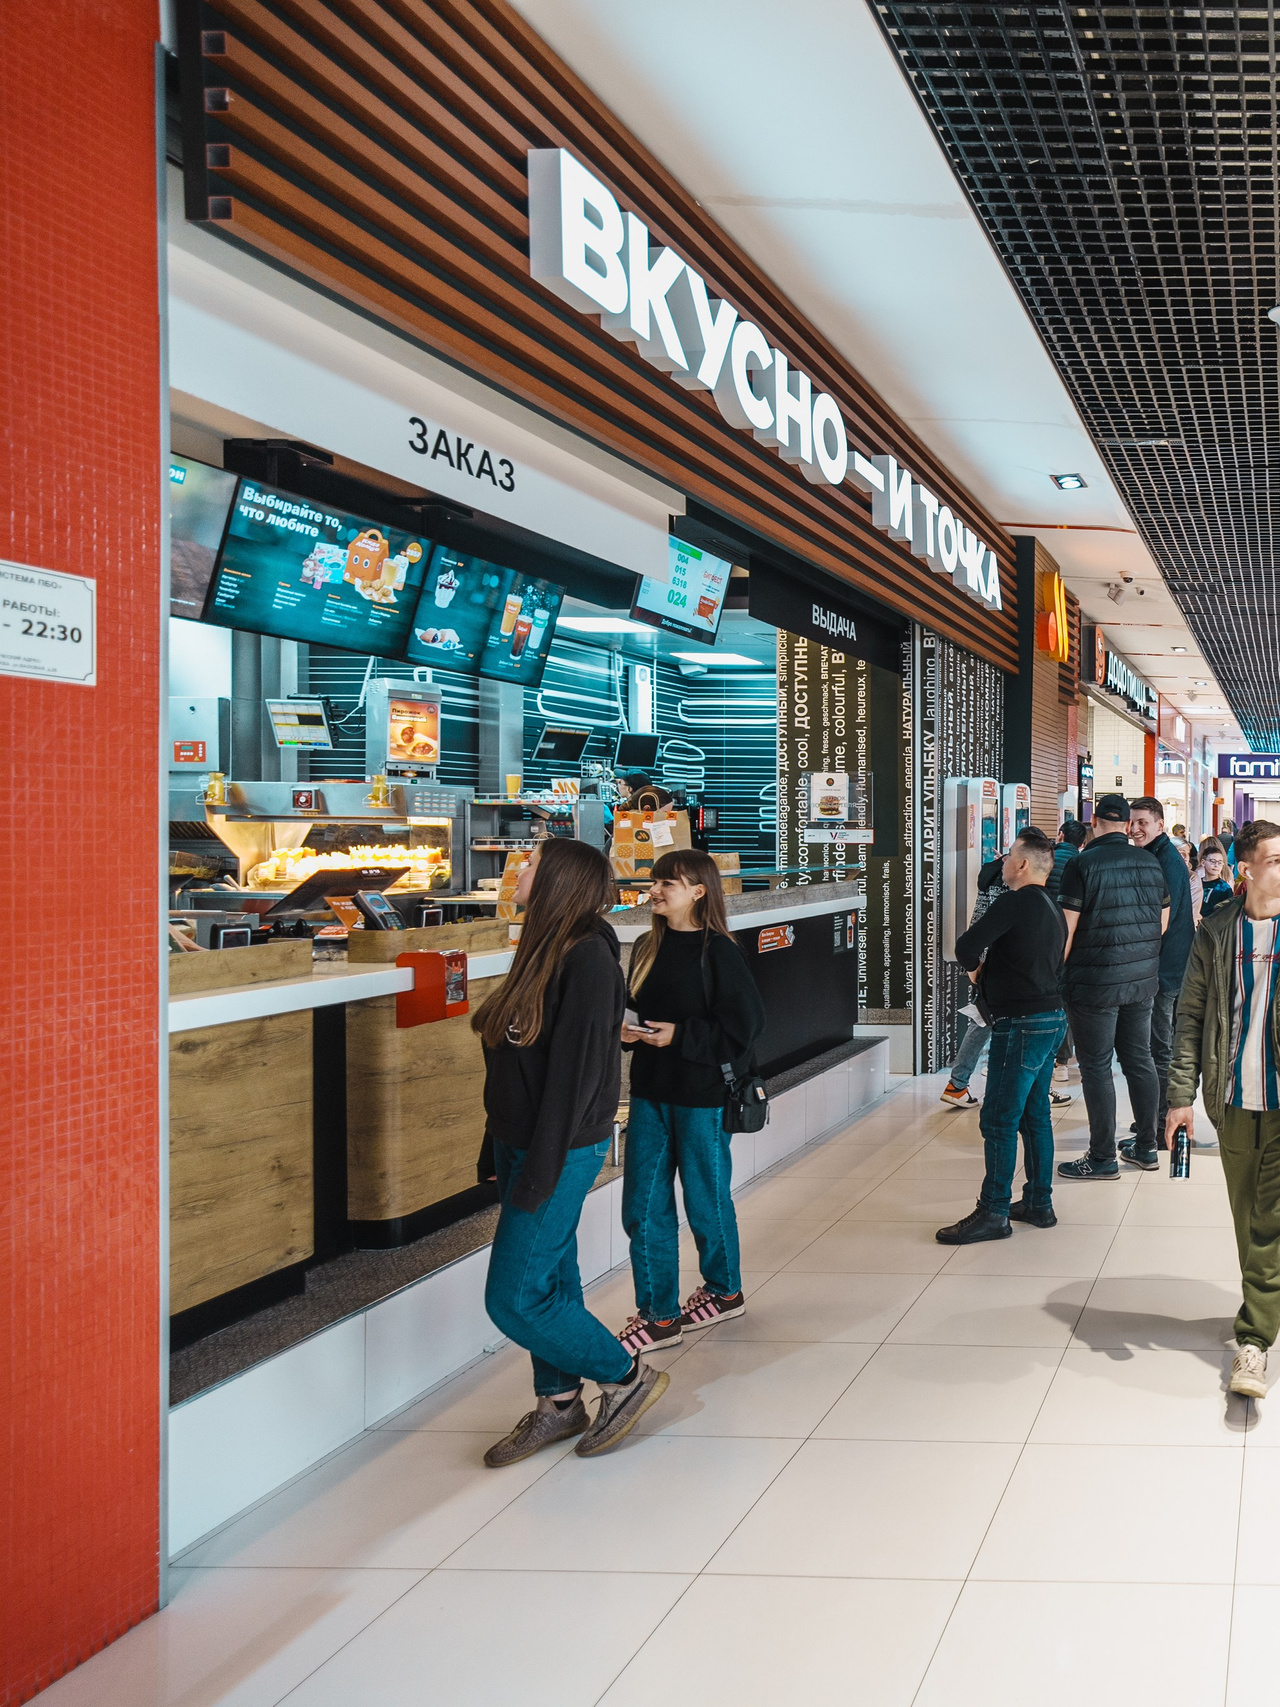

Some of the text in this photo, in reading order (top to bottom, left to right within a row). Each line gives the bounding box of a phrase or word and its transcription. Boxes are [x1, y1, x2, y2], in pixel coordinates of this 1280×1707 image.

[560, 147, 848, 485] ВКУСНО
[888, 454, 914, 541] И
[919, 485, 1003, 611] ТОЧКА
[408, 416, 515, 493] ЗАКАЗ
[239, 504, 320, 538] что любите
[242, 486, 343, 532] Выбирайте то,
[674, 564, 687, 576] 015
[677, 553, 690, 565] 004
[667, 589, 688, 608] 024
[671, 576, 688, 589] 6318
[2, 598, 62, 618] РАБОТЫ:
[811, 603, 857, 642] ВЫДАЧА
[21, 618, 82, 645] 22:30
[855, 673, 868, 723] heureux,
[1107, 650, 1147, 716] ДОДО ПИЦЦА
[391, 708, 421, 716] Пирожок
[820, 681, 830, 727] geschmack,
[831, 669, 848, 737] colourful,
[794, 733, 810, 769] cool,
[820, 728, 830, 754] fresco,
[855, 726, 868, 791] humanised,
[881, 859, 891, 1010] qualitativo, appealing, harmonisch, frais,
